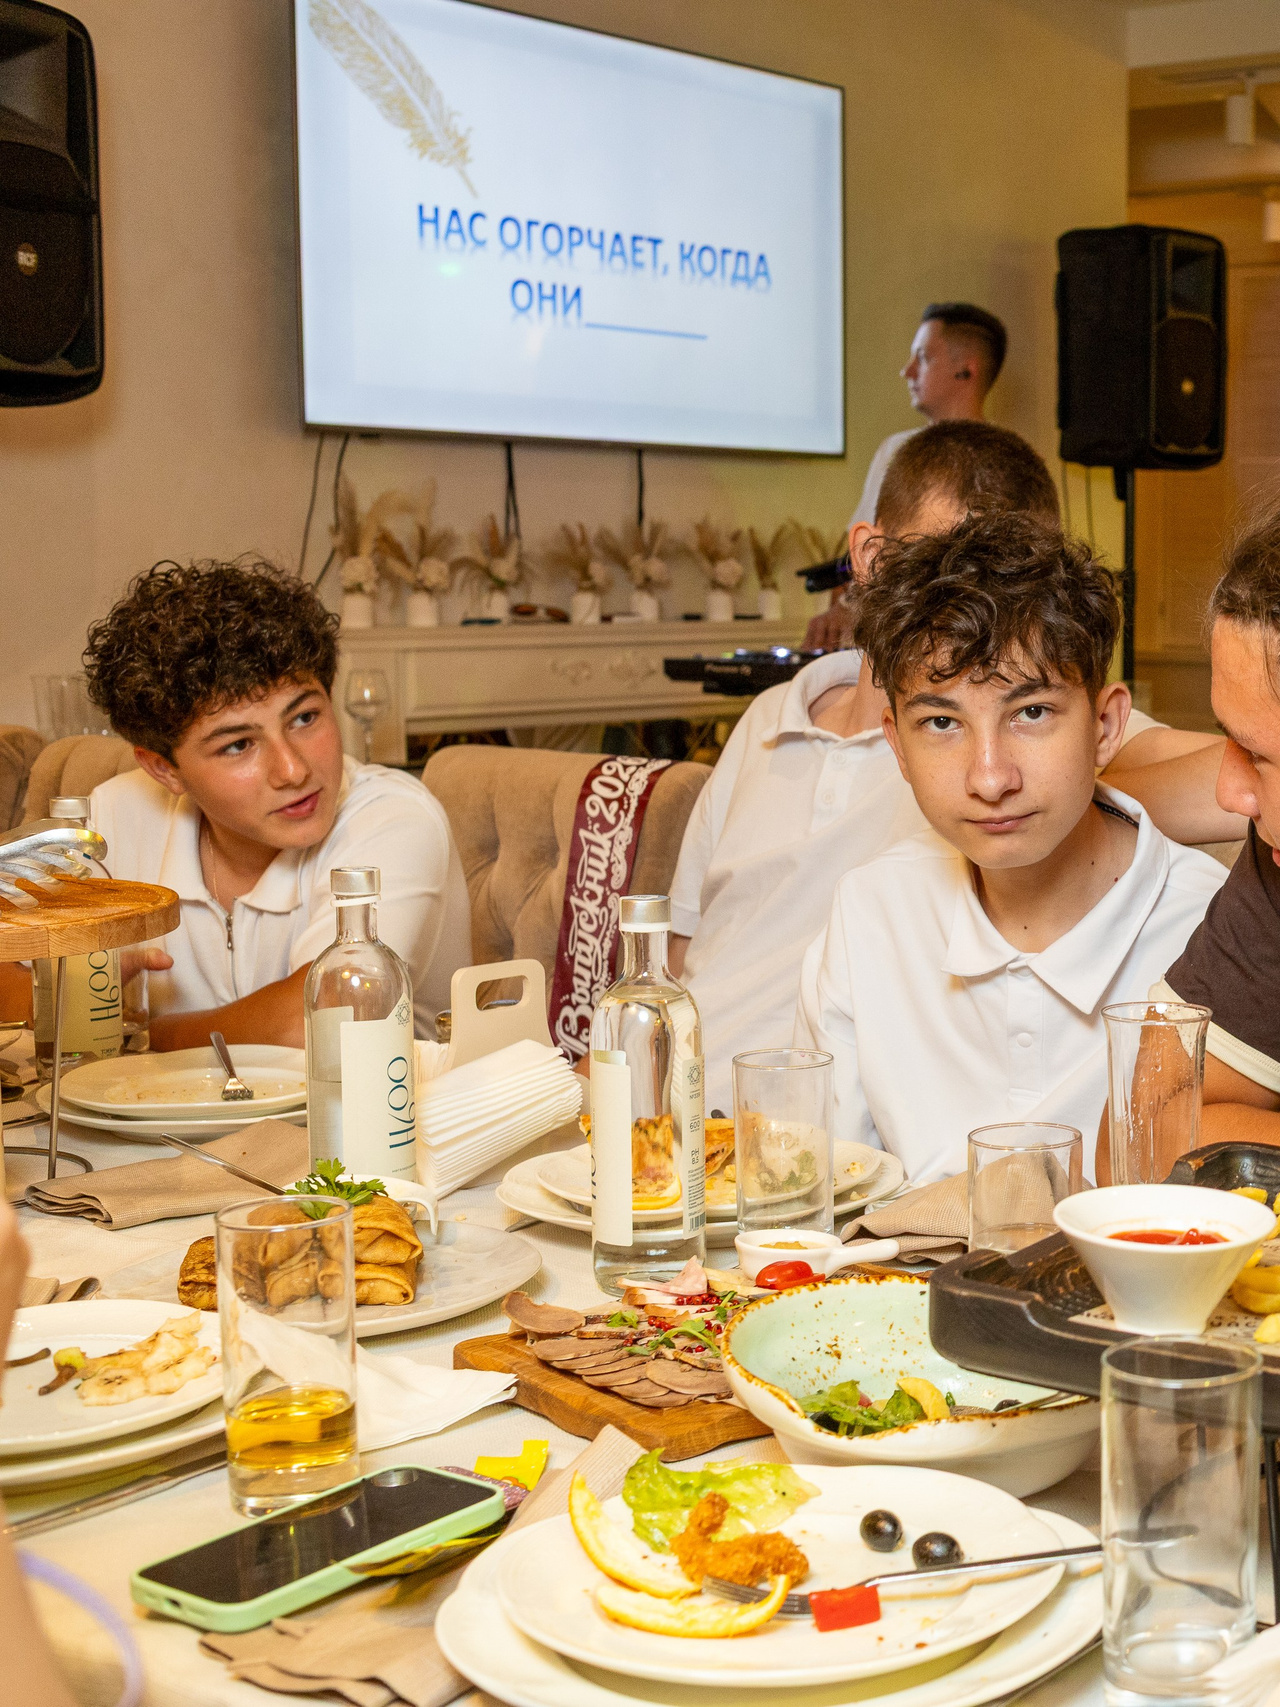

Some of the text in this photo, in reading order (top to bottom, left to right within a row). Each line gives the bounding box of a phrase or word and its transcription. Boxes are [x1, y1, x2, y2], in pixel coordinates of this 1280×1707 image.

[418, 203, 771, 290] НАС ОГОРЧАЕТ, КОГДА
[585, 756, 648, 825] 202
